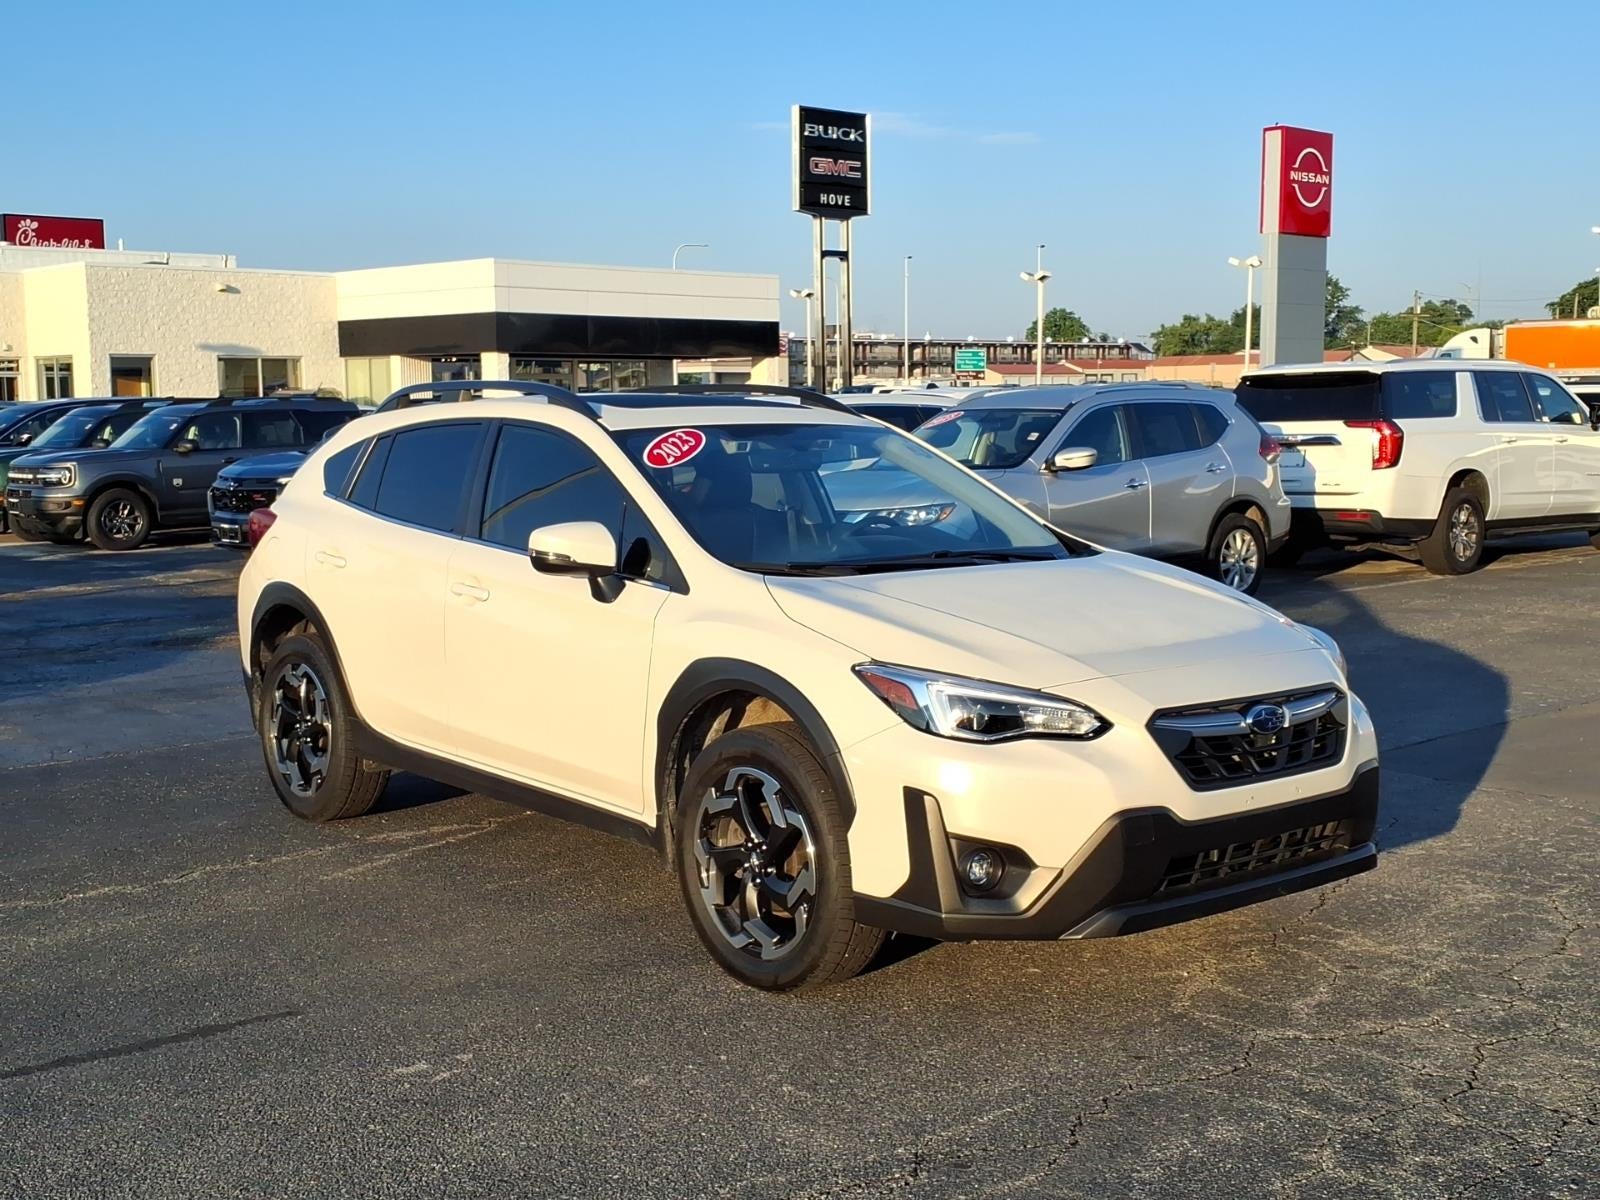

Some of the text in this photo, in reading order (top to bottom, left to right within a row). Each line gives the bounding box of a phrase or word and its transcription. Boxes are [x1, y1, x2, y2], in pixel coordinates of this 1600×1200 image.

[804, 123, 864, 142] BUICK
[810, 157, 861, 178] GMC
[1290, 170, 1329, 185] NISSAN
[820, 193, 851, 206] HOVE
[653, 432, 695, 464] 2023
